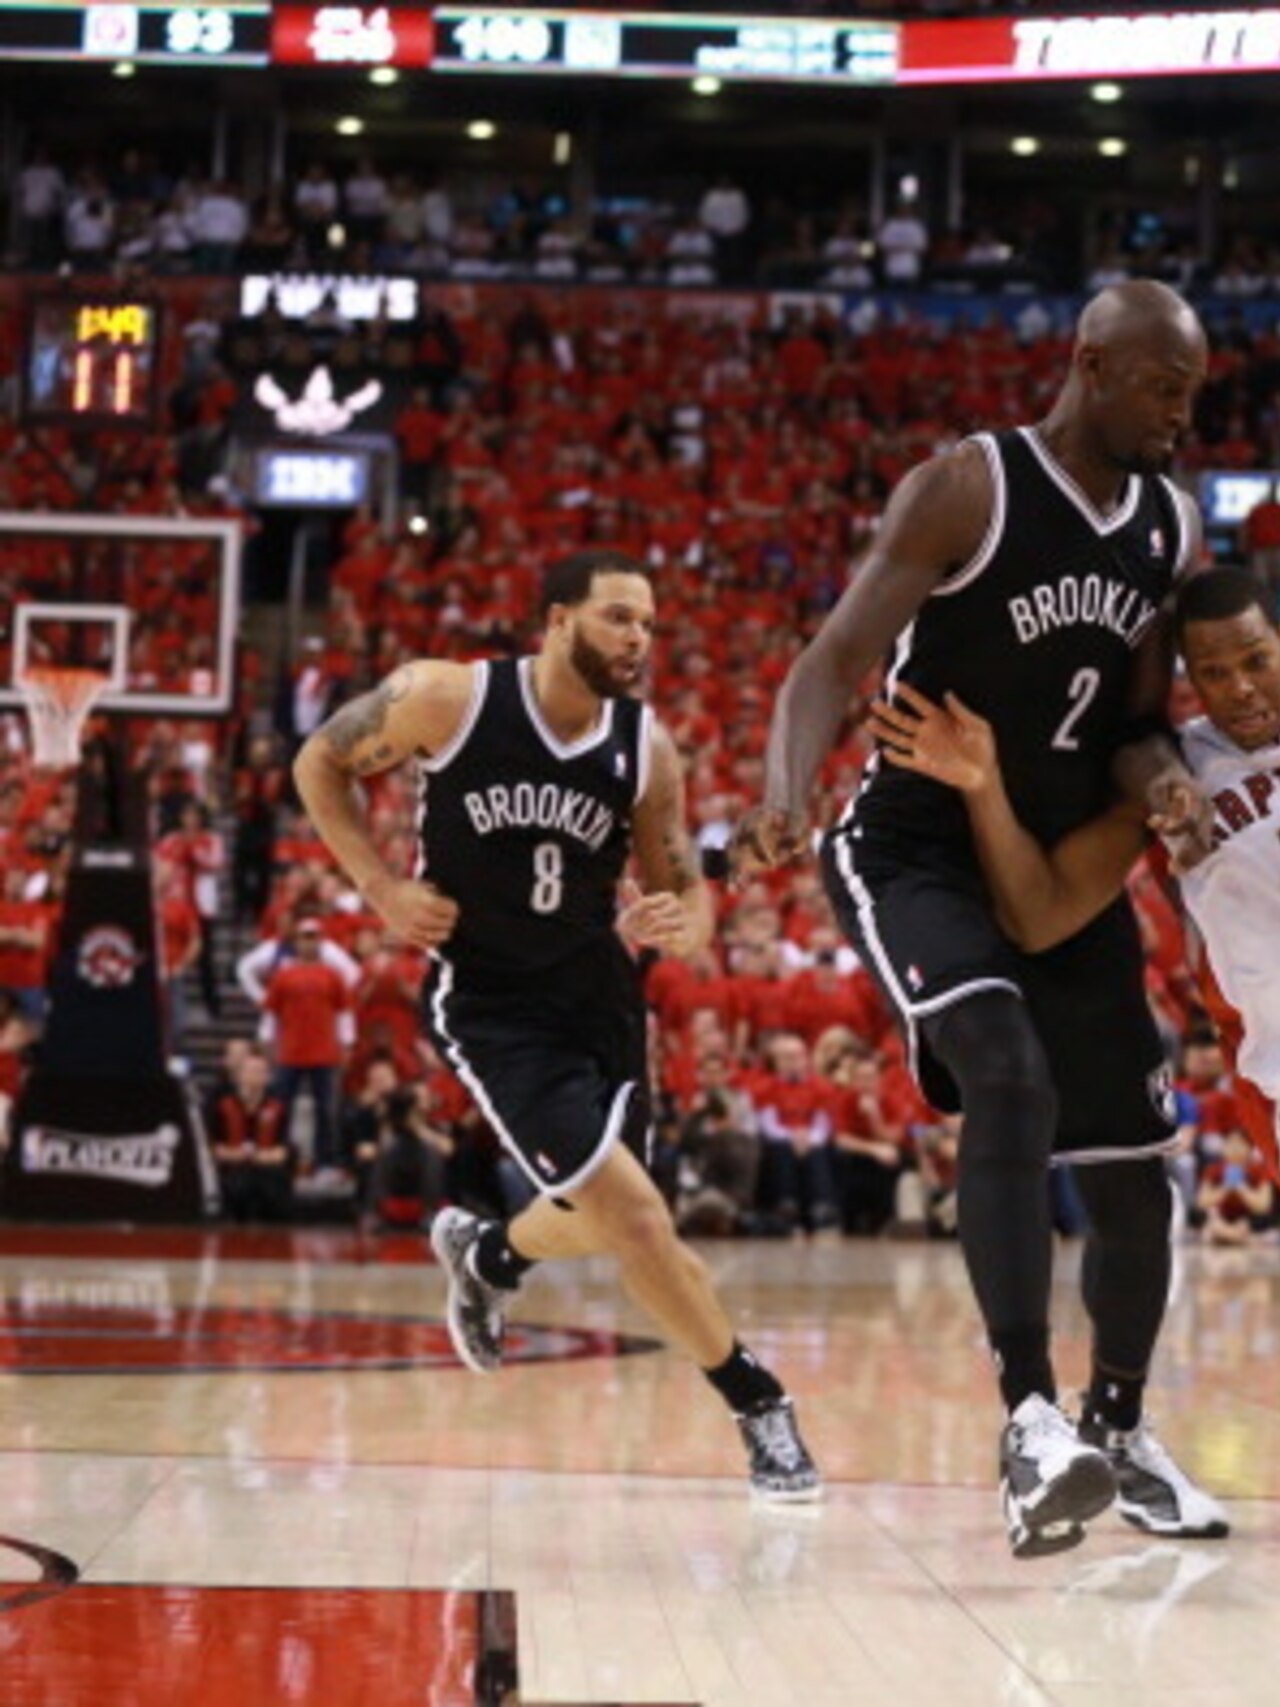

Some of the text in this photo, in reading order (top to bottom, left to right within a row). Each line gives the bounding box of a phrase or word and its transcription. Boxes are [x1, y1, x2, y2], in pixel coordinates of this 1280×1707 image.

[1008, 573, 1156, 650] BROOKLY
[1051, 666, 1100, 750] 2
[530, 842, 563, 915] 8
